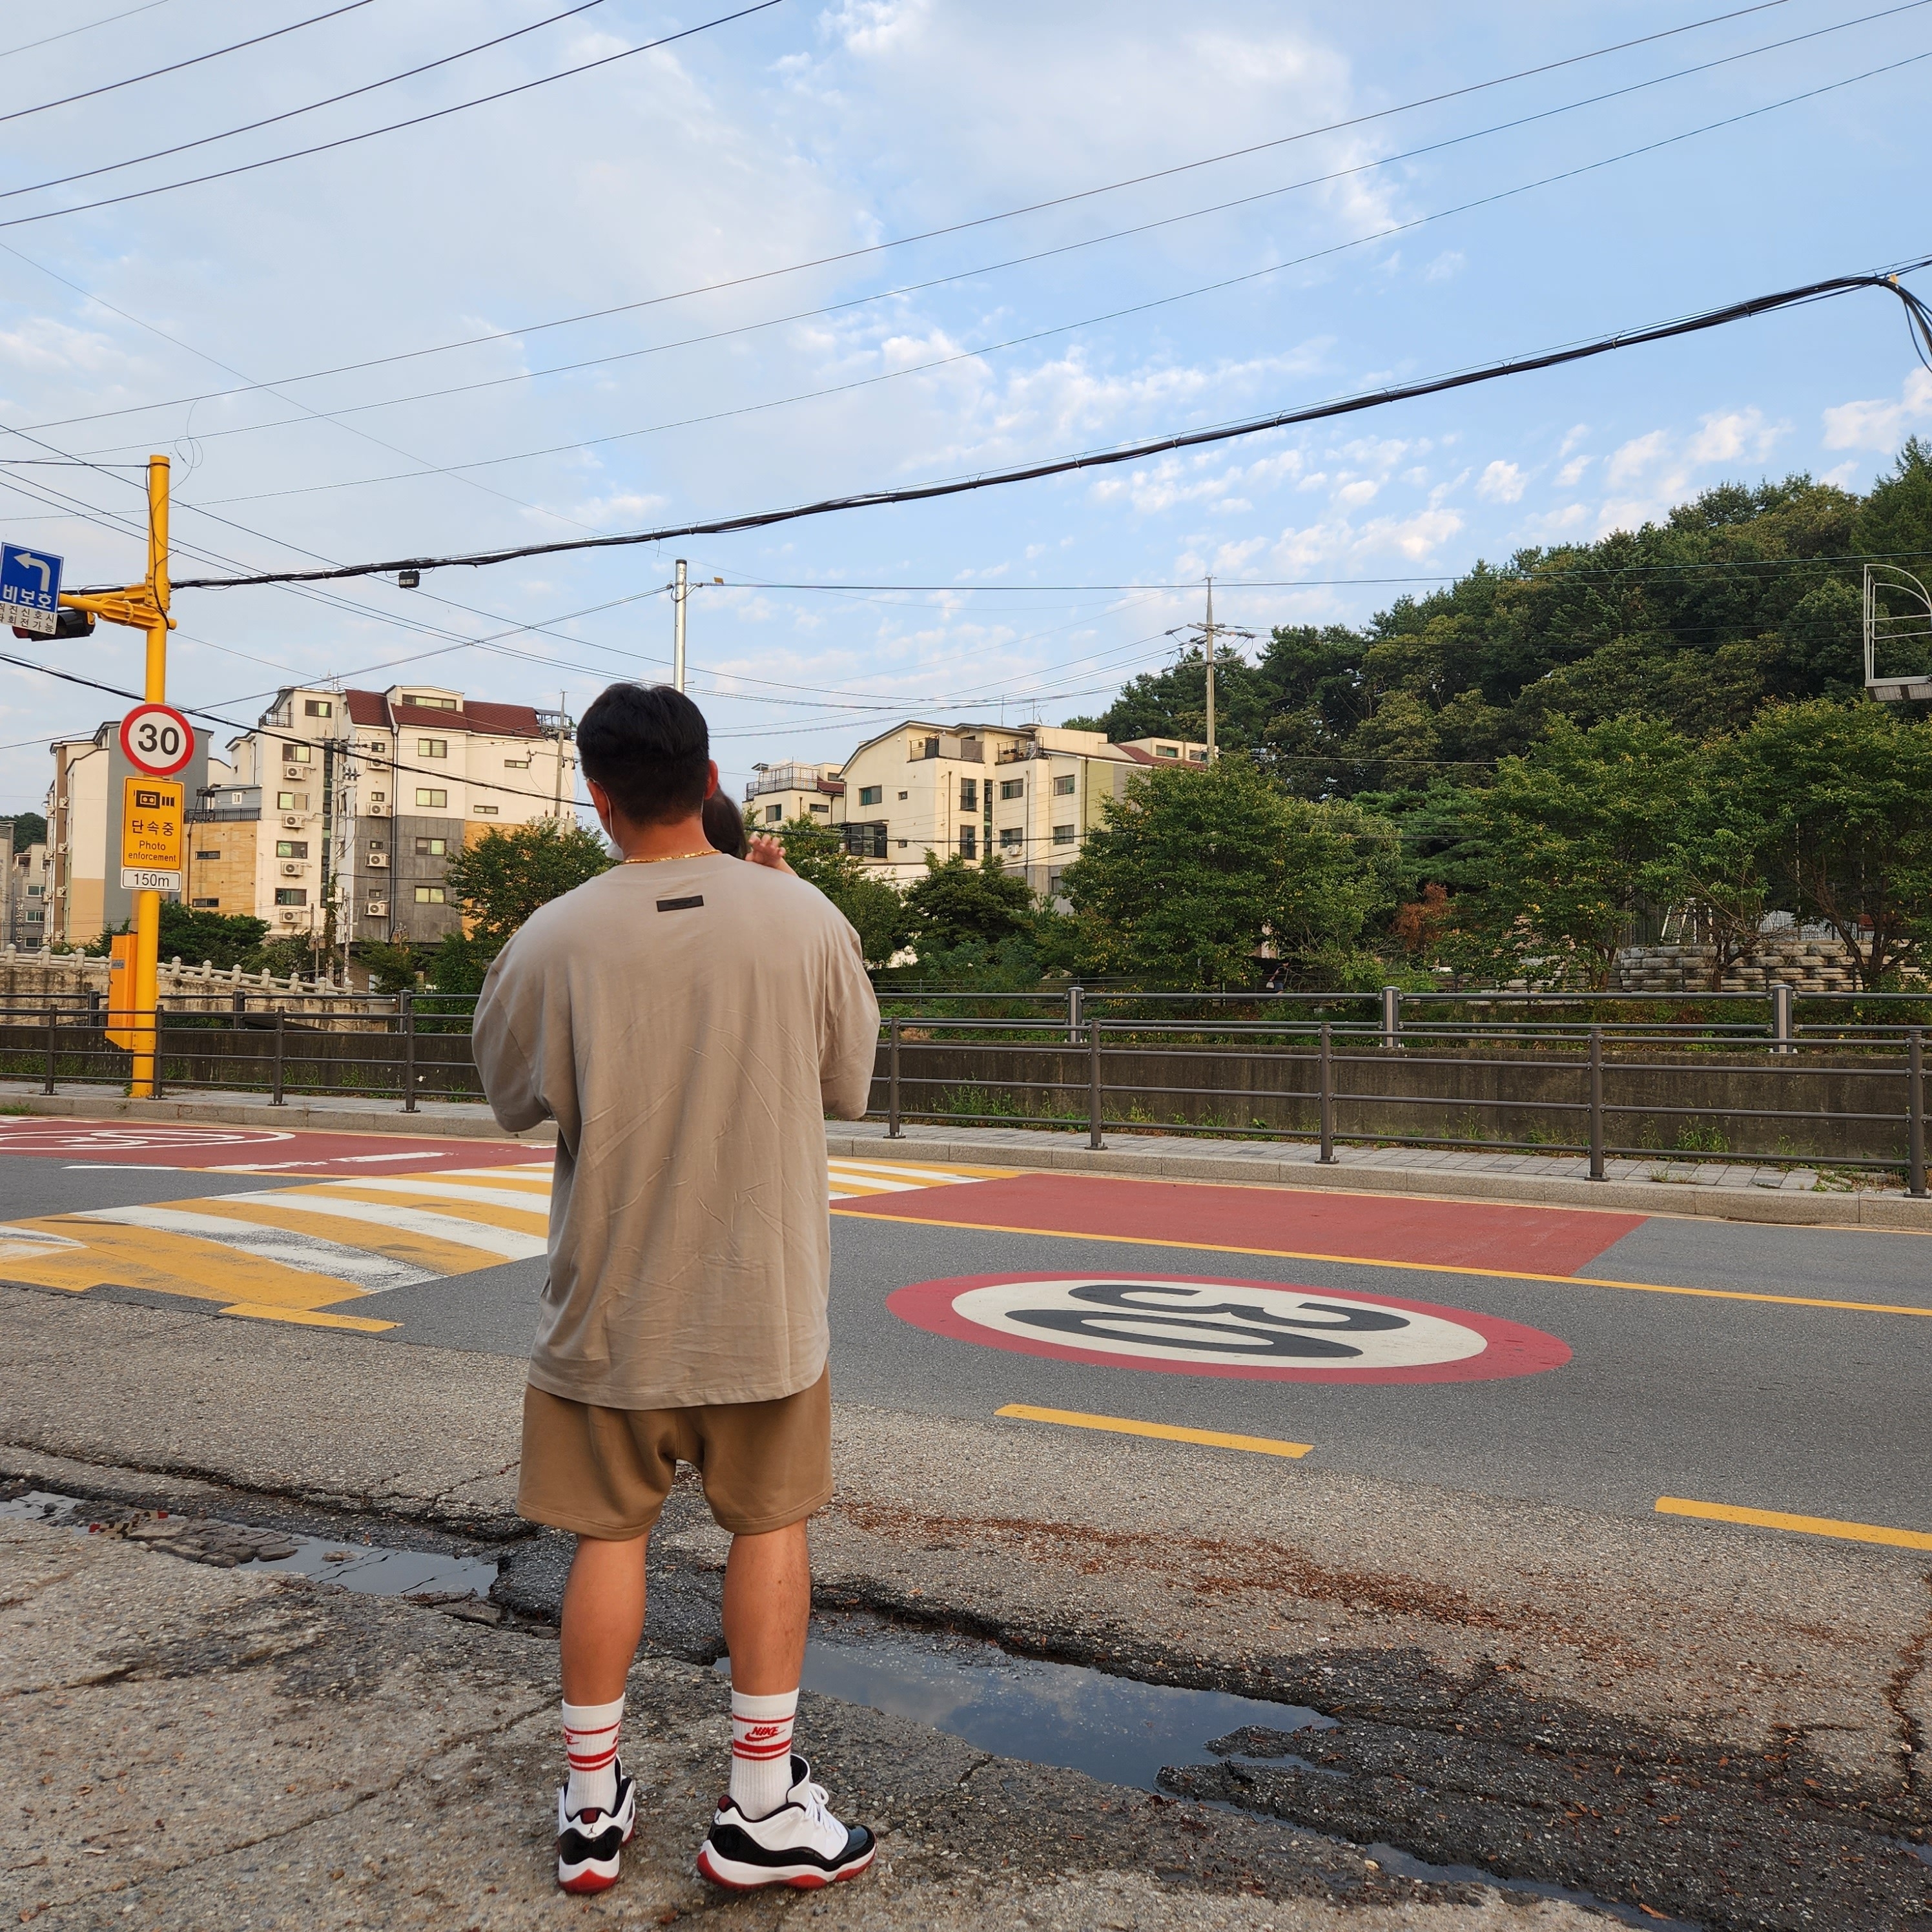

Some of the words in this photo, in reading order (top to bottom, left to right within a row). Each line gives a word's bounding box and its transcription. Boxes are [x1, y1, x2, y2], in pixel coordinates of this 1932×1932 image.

[3, 584, 52, 610] 비보호
[138, 723, 180, 755] 30
[132, 819, 174, 836] 단속중
[139, 840, 166, 850] Photo
[128, 852, 176, 862] enforcement
[134, 873, 169, 887] 150m
[1004, 1283, 1411, 1359] 30
[751, 1726, 779, 1736] NIKE
